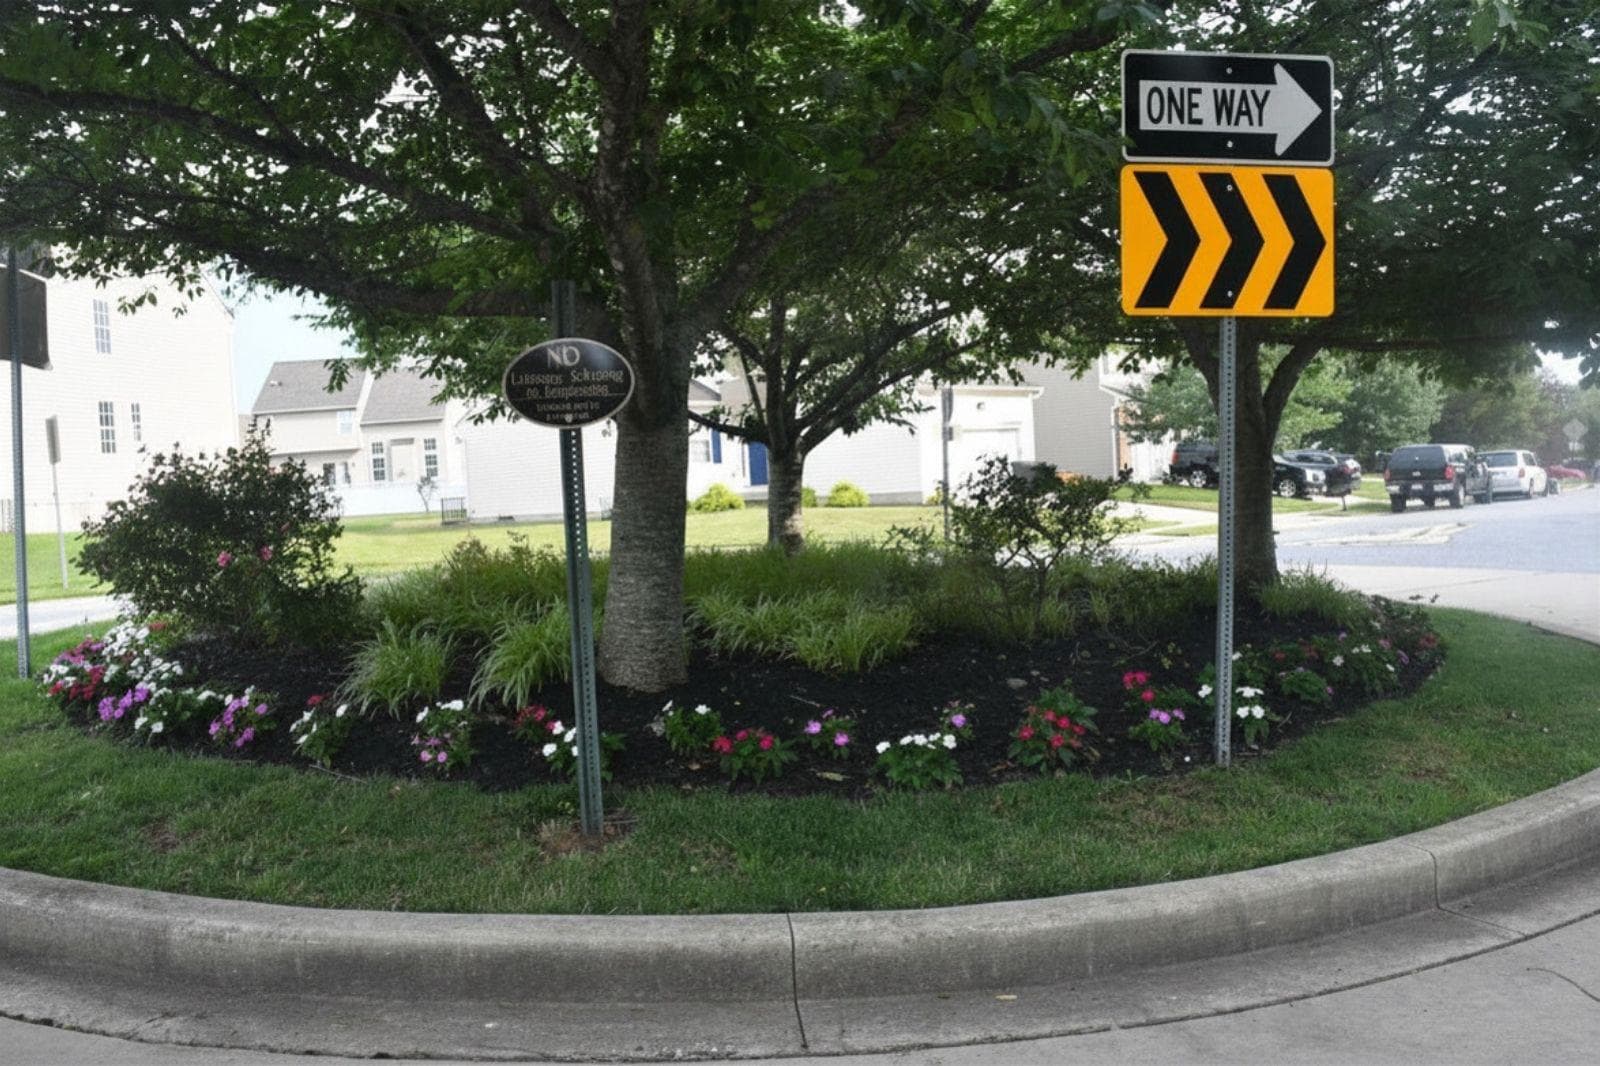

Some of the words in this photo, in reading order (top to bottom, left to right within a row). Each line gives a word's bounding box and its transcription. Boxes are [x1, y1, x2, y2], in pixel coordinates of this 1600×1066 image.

[1147, 86, 1203, 125] ONE
[1213, 88, 1271, 127] WAY
[547, 345, 581, 367] NO
